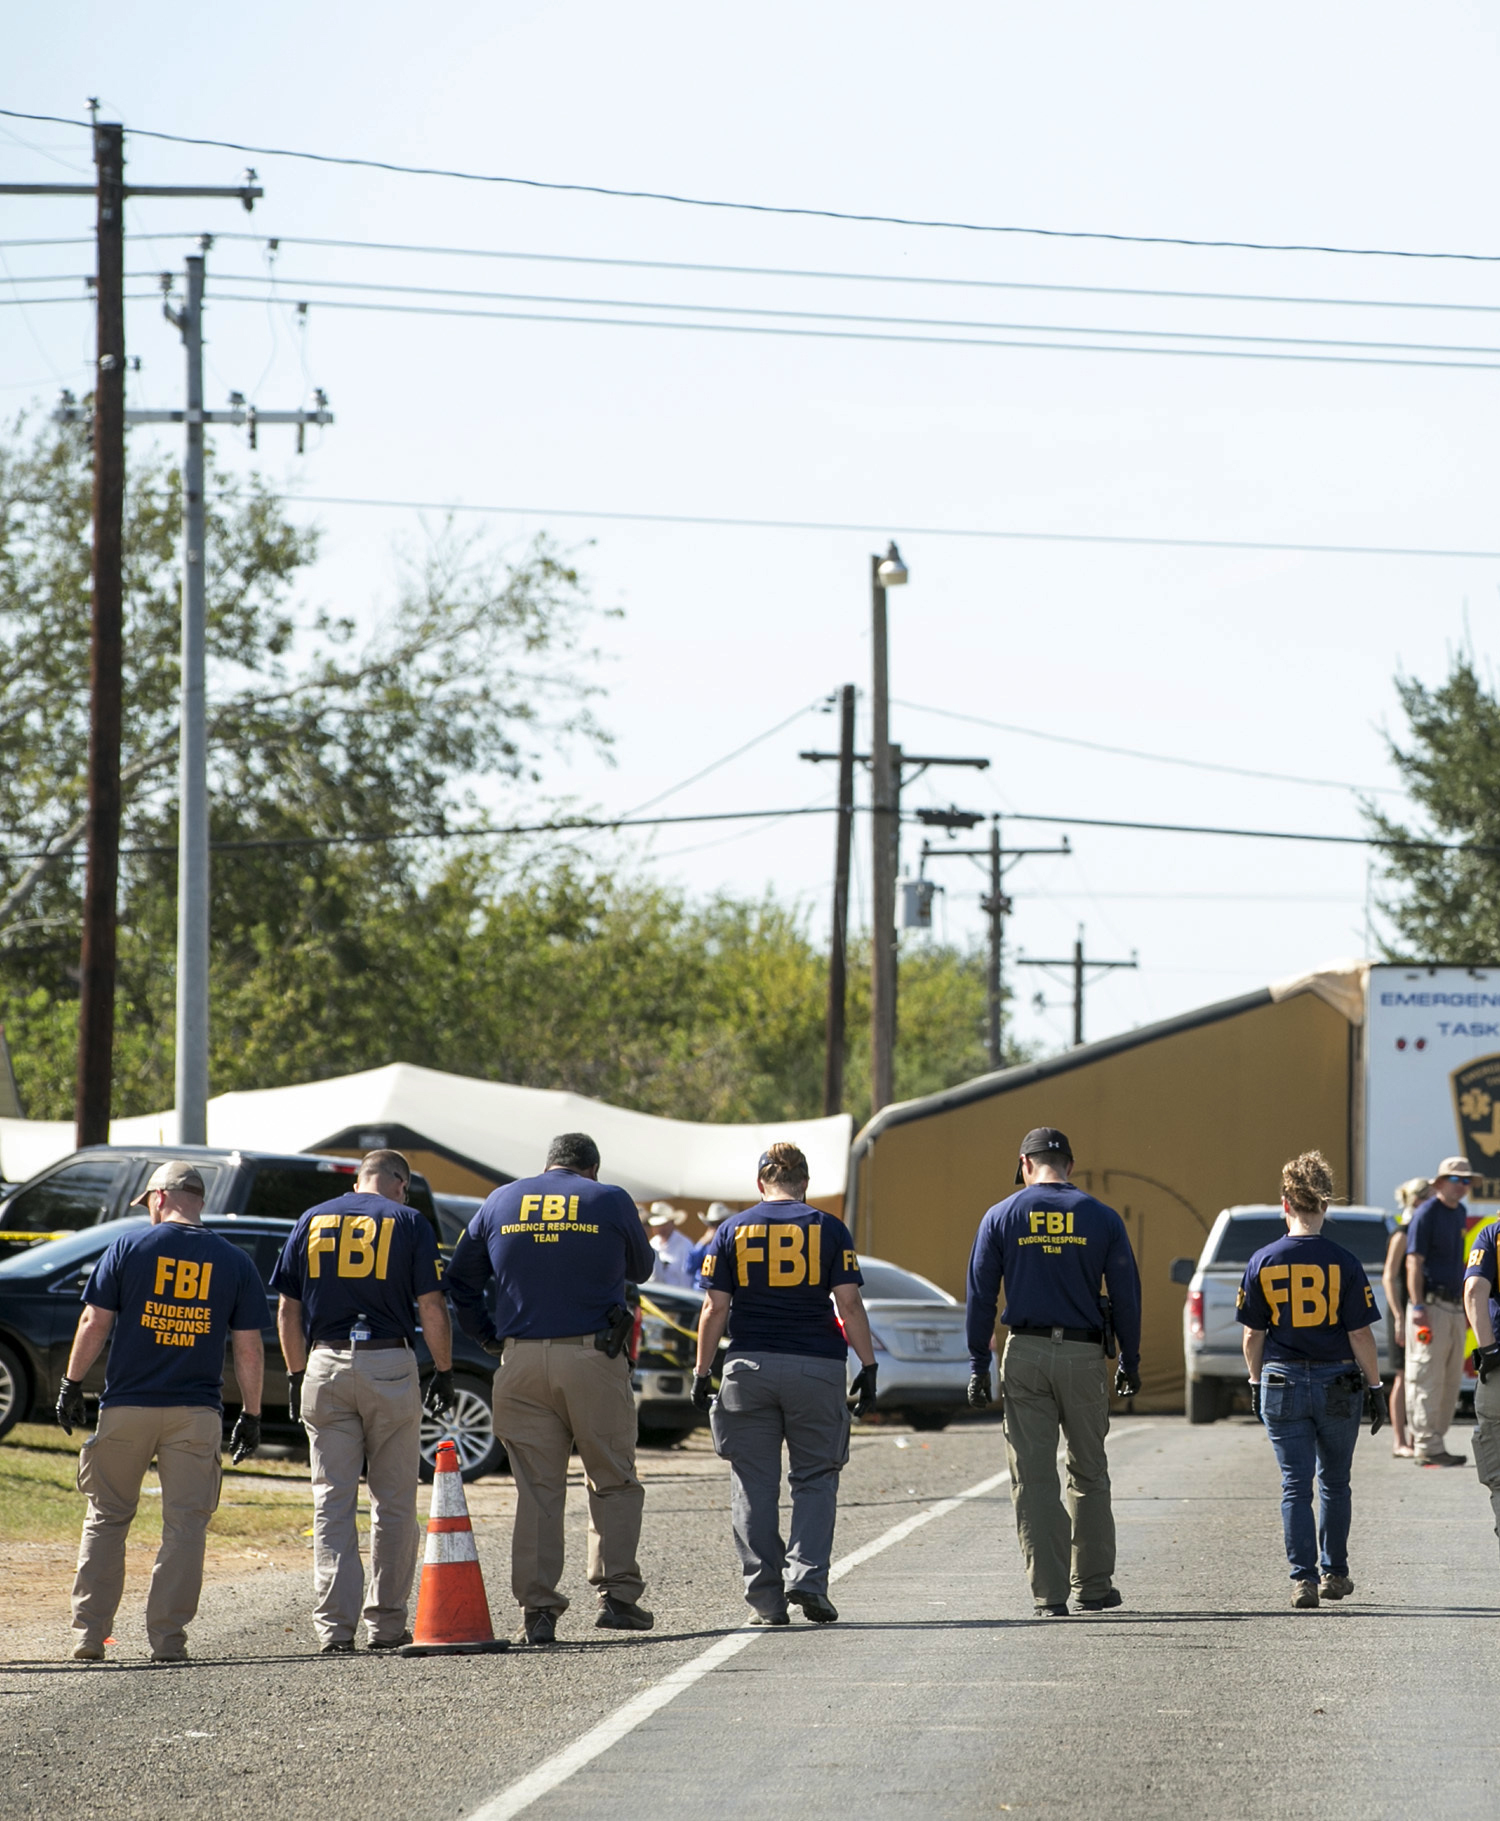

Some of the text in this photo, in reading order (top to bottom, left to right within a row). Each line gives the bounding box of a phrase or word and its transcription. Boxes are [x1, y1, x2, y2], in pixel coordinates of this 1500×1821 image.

[1437, 1021, 1500, 1038] TASK
[519, 1194, 579, 1221] FBI
[501, 1222, 599, 1235] EVIDENCE RESPONSE
[1029, 1211, 1074, 1234] FBI
[308, 1214, 396, 1280] FBI
[533, 1233, 559, 1243] TEAM
[1018, 1236, 1088, 1246] EVIDENCE RESPONSE
[735, 1223, 821, 1287] FBI
[1042, 1245, 1062, 1254] TEAM
[154, 1256, 213, 1300] FBI
[1260, 1264, 1341, 1328] FBI
[145, 1301, 211, 1320] EVIDENCE
[141, 1314, 211, 1334] RESPONSE
[154, 1331, 196, 1347] TEAM
